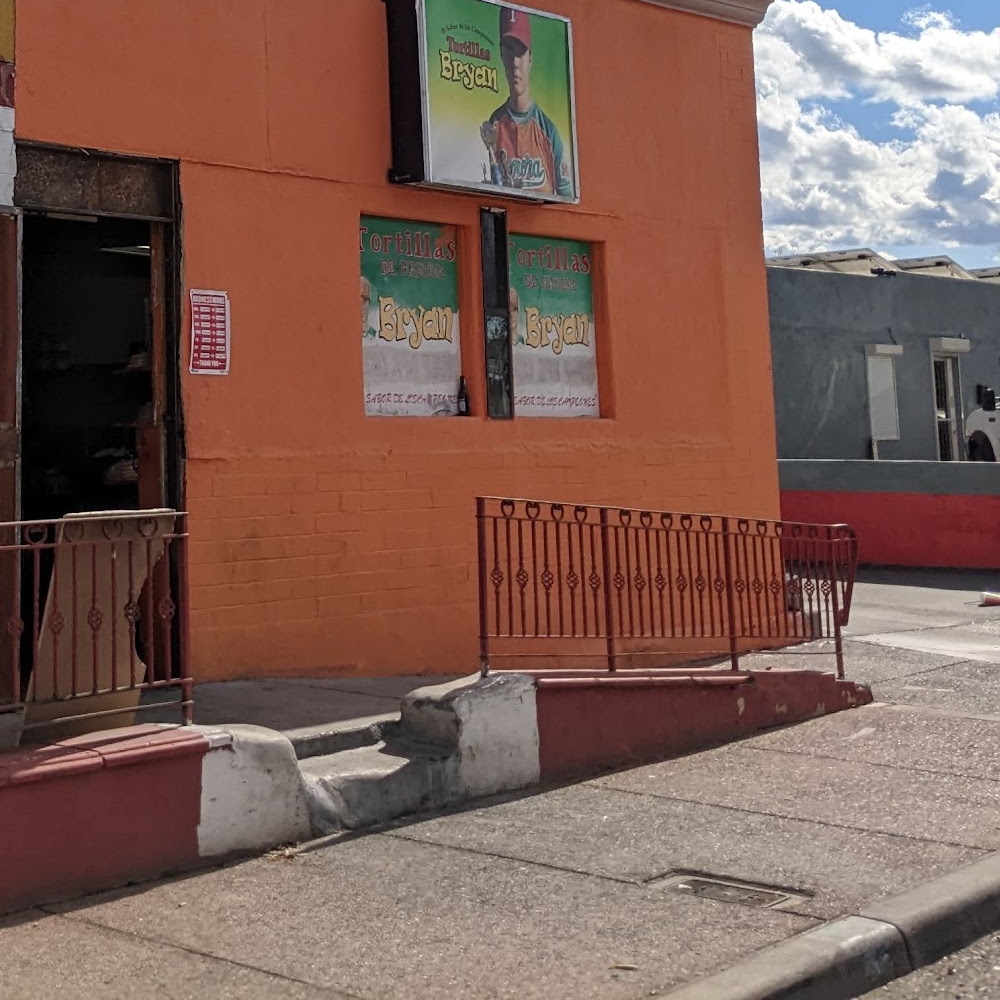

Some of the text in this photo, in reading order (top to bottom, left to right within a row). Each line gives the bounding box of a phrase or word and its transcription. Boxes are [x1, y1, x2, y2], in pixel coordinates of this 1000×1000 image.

[439, 49, 499, 93] Bryan
[446, 36, 490, 61] Tortillas
[378, 295, 454, 349] Bryan
[524, 306, 590, 354] Bryan
